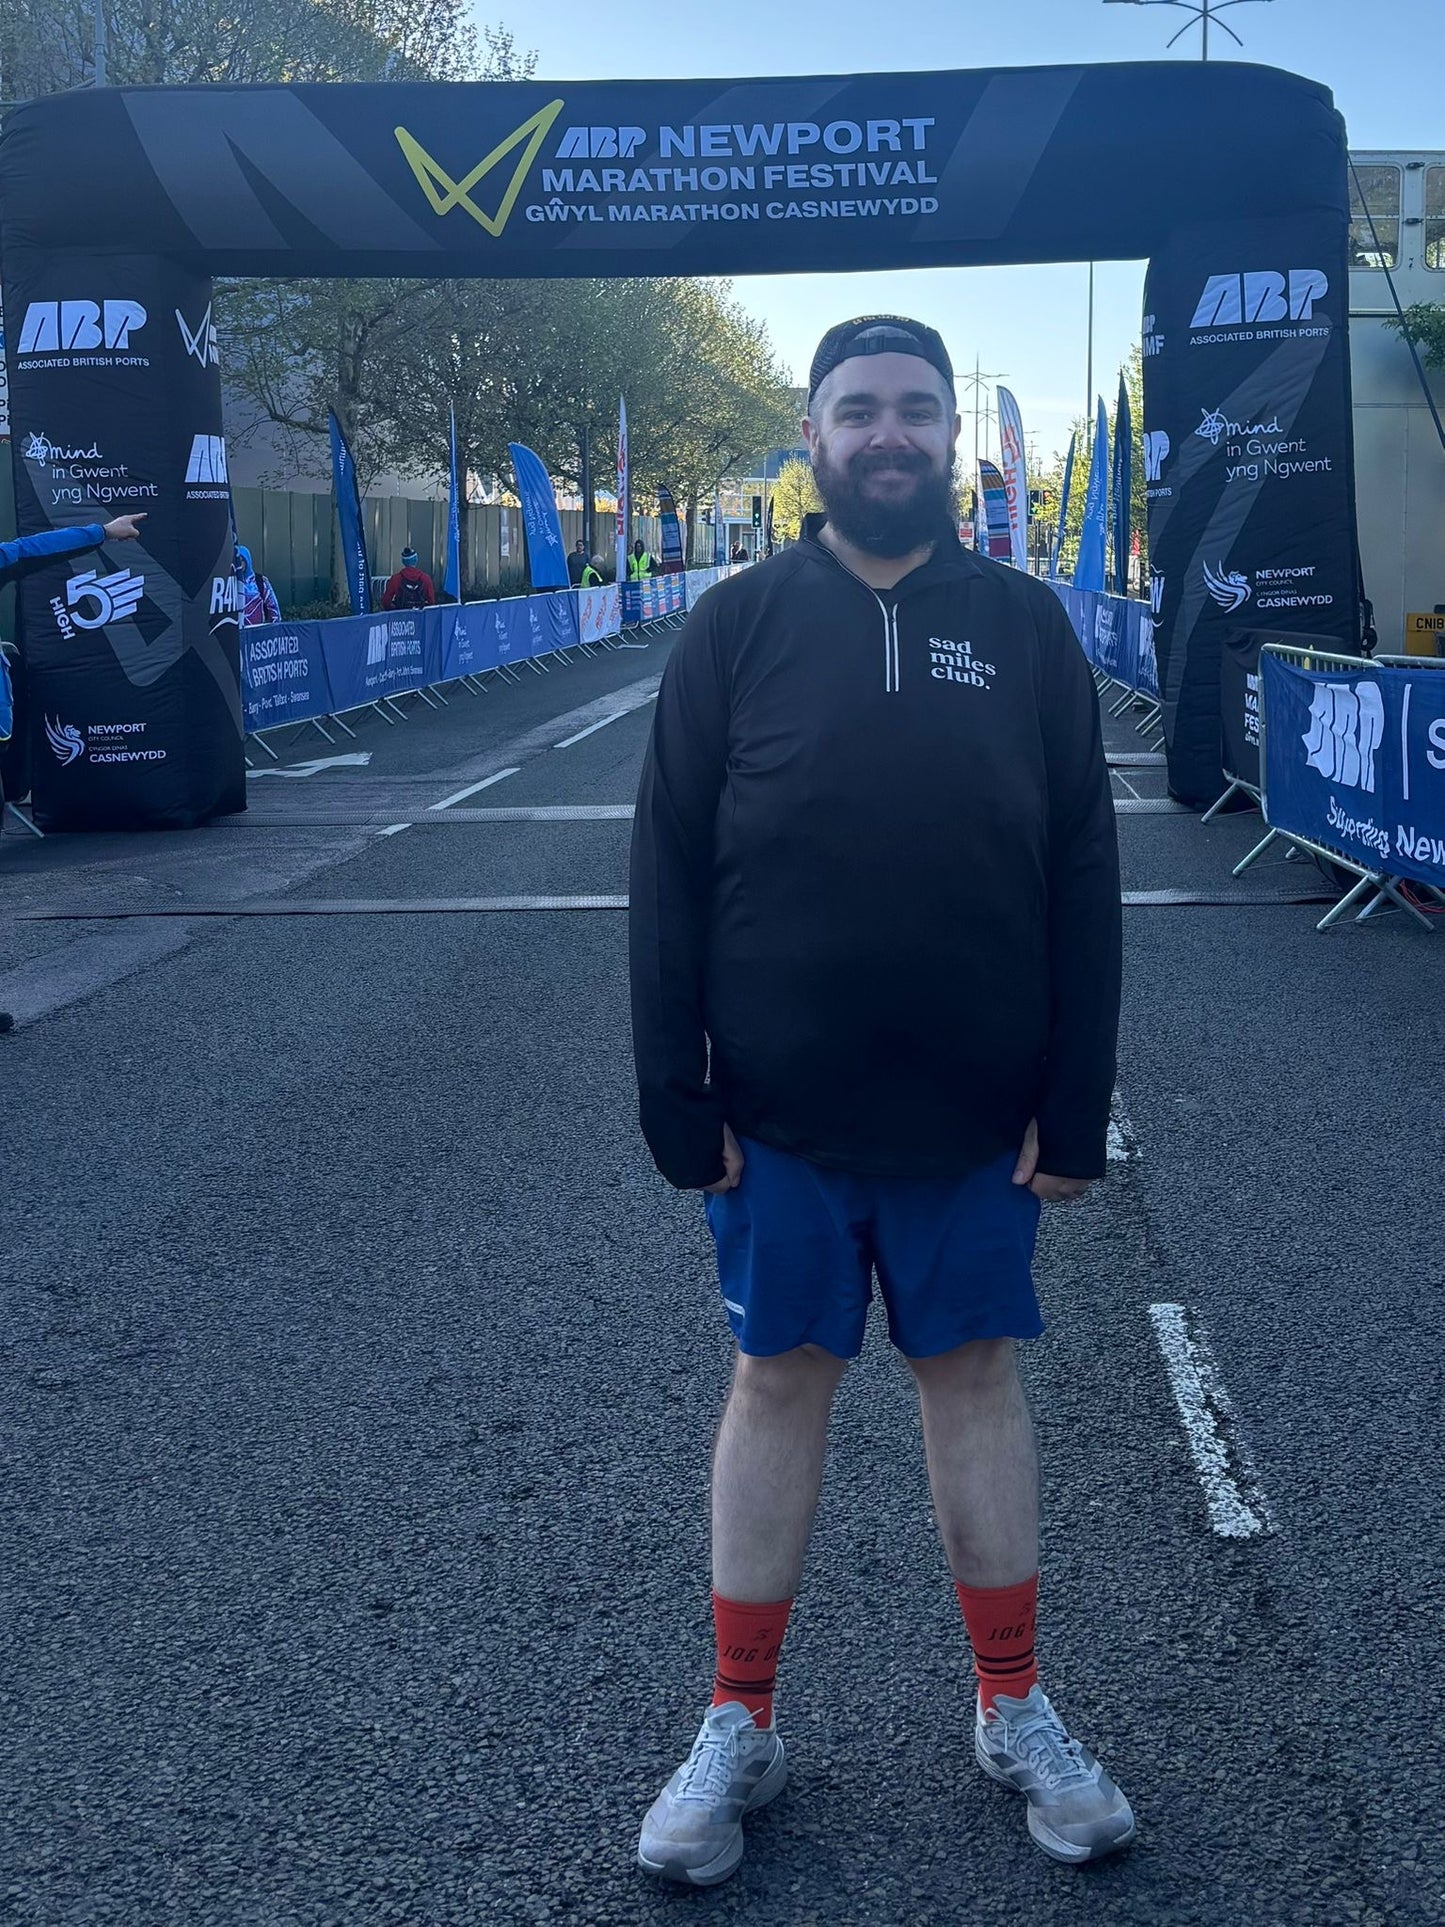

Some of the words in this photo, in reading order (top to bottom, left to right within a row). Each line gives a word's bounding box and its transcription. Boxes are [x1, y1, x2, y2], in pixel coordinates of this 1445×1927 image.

[555, 126, 647, 159] ABP
[659, 117, 936, 158] NEWPORT
[541, 166, 755, 192] MARATHON
[764, 160, 938, 188] FESTIVAL
[526, 196, 604, 223] GŴYL
[608, 202, 760, 221] MARATHON
[765, 196, 939, 219] CASNEWYDD
[1189, 269, 1329, 328] ABP
[17, 299, 147, 354] ABP
[1190, 332, 1254, 346] ASSOCIATED
[1256, 329, 1297, 340] BRITISH
[1299, 327, 1329, 337] PORTS
[18, 358, 70, 370] ASSOCIATED
[72, 356, 113, 367] BRITISH
[115, 357, 150, 367] PORTS
[1226, 416, 1283, 435] mind
[50, 442, 103, 460] mind
[1226, 442, 1242, 457] in
[1246, 438, 1307, 456] Gwent
[52, 464, 66, 479] in
[69, 463, 129, 478] Gwent
[1226, 464, 1259, 483] yng
[1264, 456, 1333, 480] Ngwent
[52, 487, 82, 505] yng
[86, 482, 158, 503] Ngwent
[1256, 566, 1316, 579] NEWPORT
[1257, 594, 1334, 608] CASNEWYDD
[50, 596, 76, 640] HIGH
[250, 636, 299, 662] ASSOCIATED
[928, 637, 972, 655] sad
[252, 662, 283, 687] BRITISH
[283, 659, 309, 679] PORTS
[930, 652, 996, 676] miles
[931, 666, 991, 690] club.
[88, 722, 147, 735] NEWPORT
[89, 750, 167, 763] CASNEWYDD
